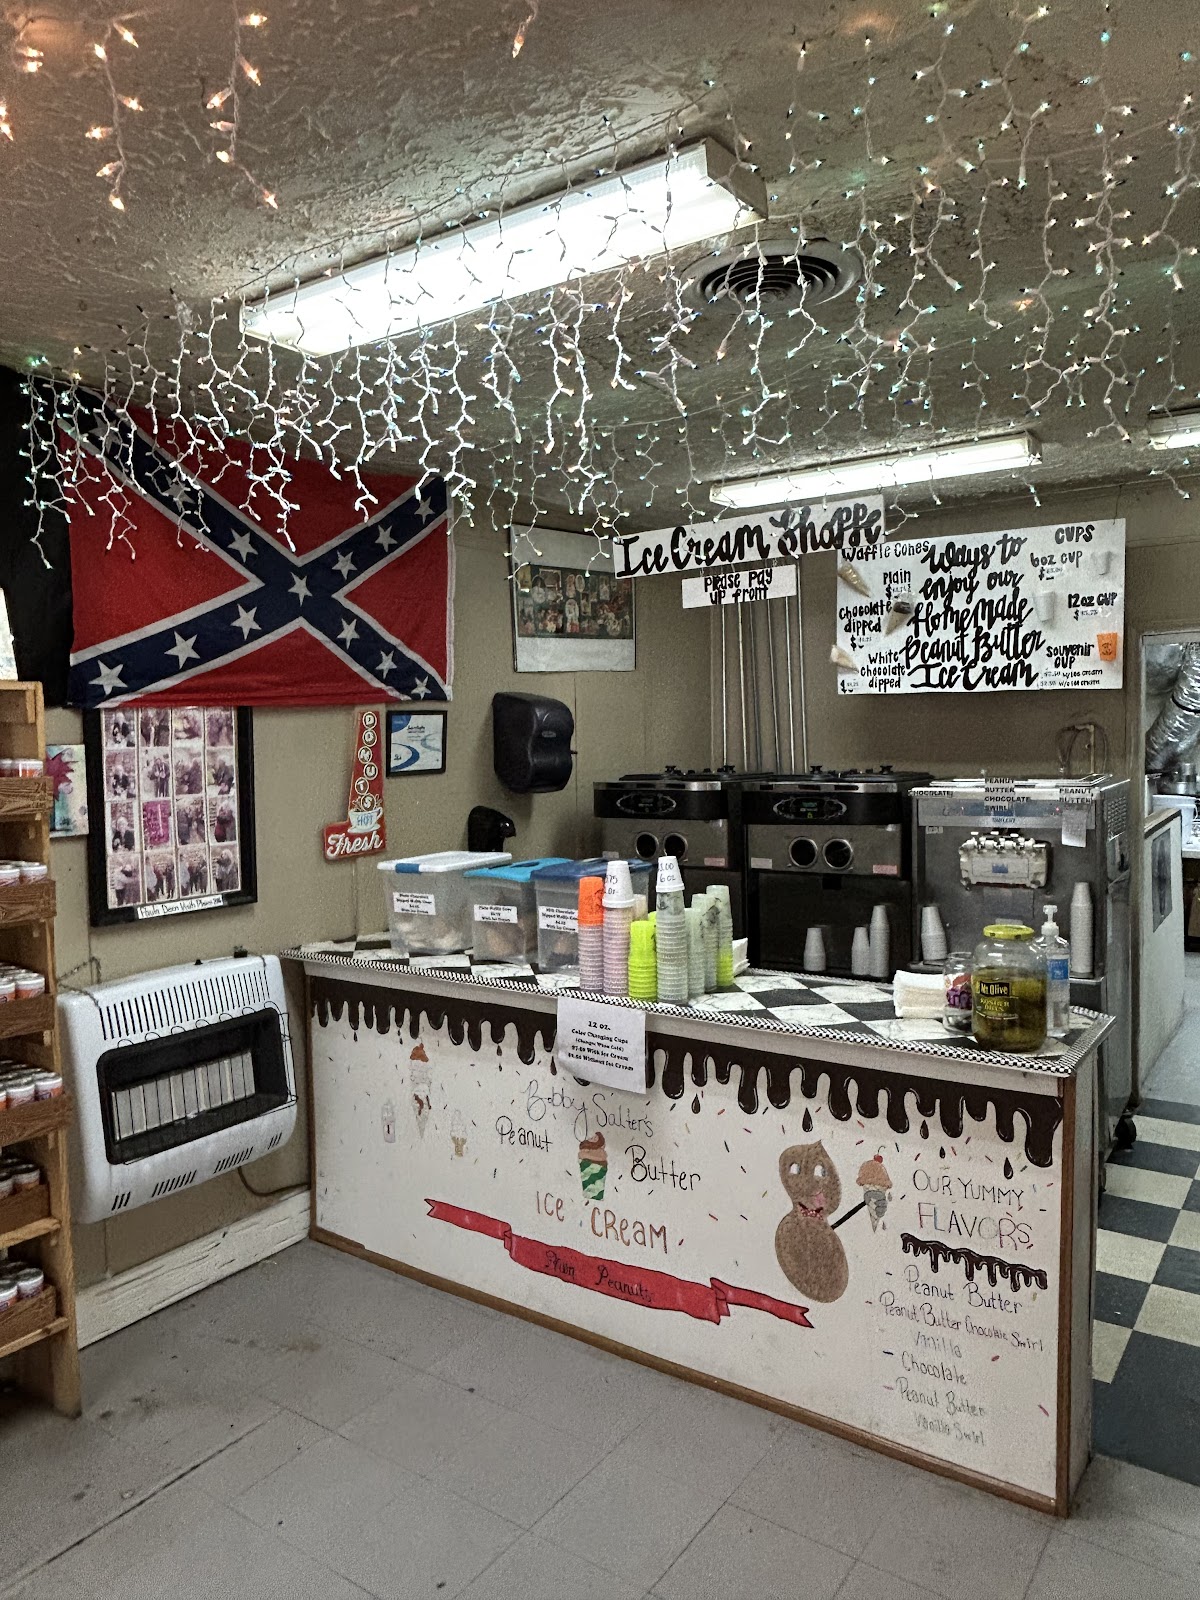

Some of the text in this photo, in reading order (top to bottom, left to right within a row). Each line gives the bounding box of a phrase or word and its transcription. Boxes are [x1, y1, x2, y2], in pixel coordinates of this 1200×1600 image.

[616, 503, 881, 577] Ice Cream Shoppe
[842, 541, 929, 562] Waffle Cones
[1055, 525, 1095, 544] CUPS
[921, 533, 1027, 578] Ways to
[919, 570, 1024, 605] enjoy our
[899, 623, 1046, 669] Peanut Butter
[907, 658, 1039, 690] Ice Cream
[326, 831, 383, 857] Fresh
[990, 984, 1008, 995] Olive
[588, 1020, 598, 1029] 12
[521, 1079, 653, 1143] Bobby Salter's
[495, 1115, 701, 1191] Peanut Butter
[913, 1169, 1024, 1206] OUR YUMMY
[918, 1202, 1033, 1250] FLAVORS
[904, 1264, 1022, 1314] Peanut Butter
[880, 1290, 920, 1323] Peanut
[920, 1302, 962, 1330] Butter
[901, 1350, 967, 1385] Chocolate
[896, 1376, 986, 1417] Peanut Butter
